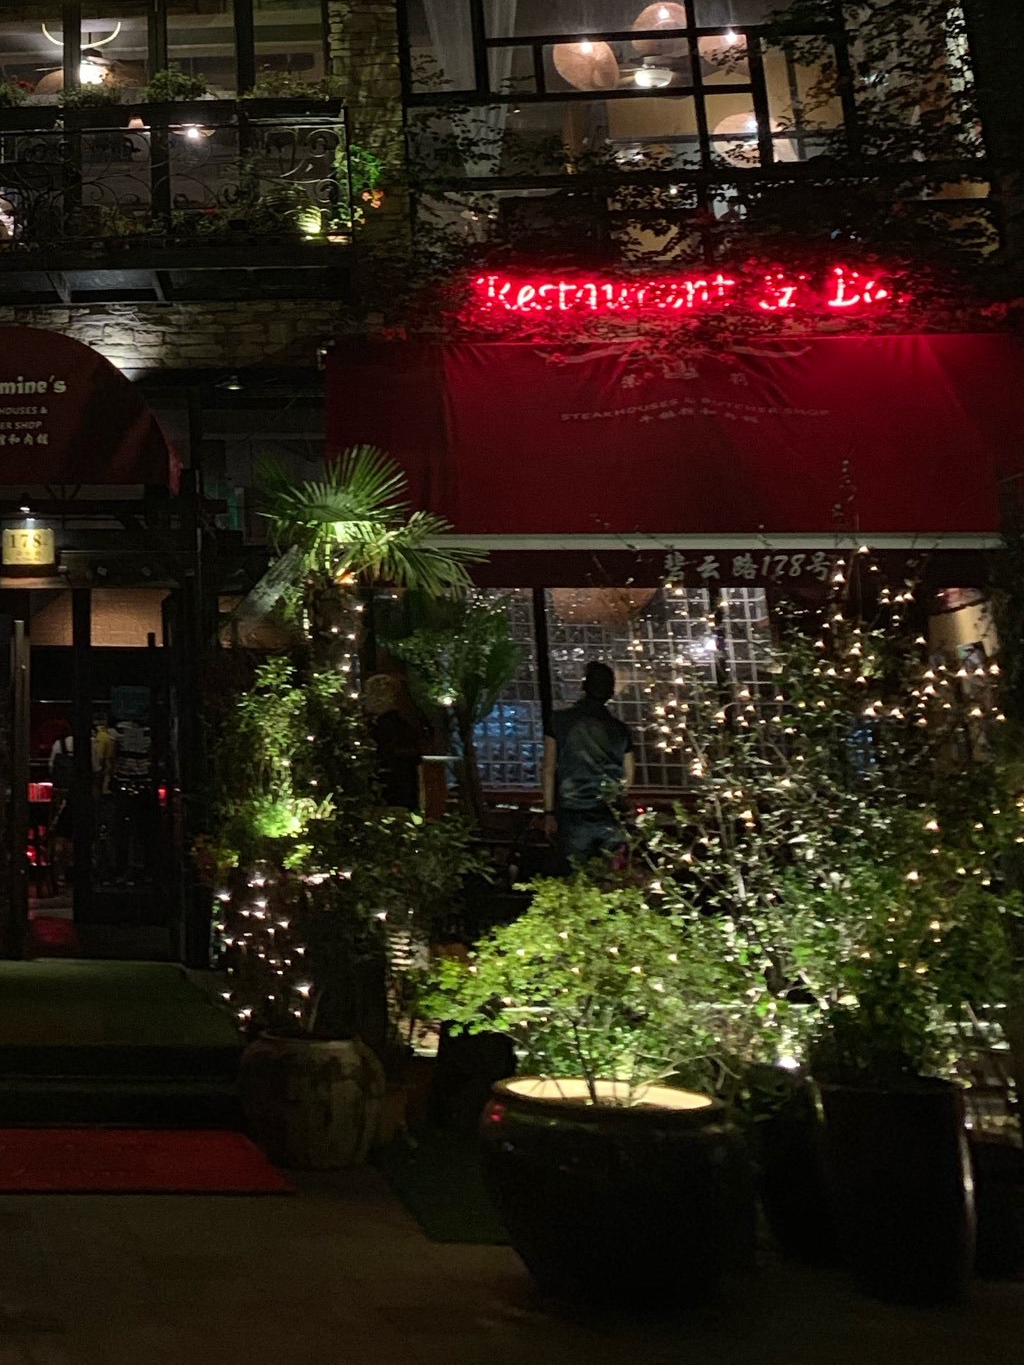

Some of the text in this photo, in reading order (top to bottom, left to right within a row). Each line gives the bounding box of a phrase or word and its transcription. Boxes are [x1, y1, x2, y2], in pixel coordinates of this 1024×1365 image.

[40, 406, 48, 414] &
[561, 397, 679, 421] STEAKHOUSES
[784, 408, 830, 417] SHOP
[15, 421, 43, 430] SHOP
